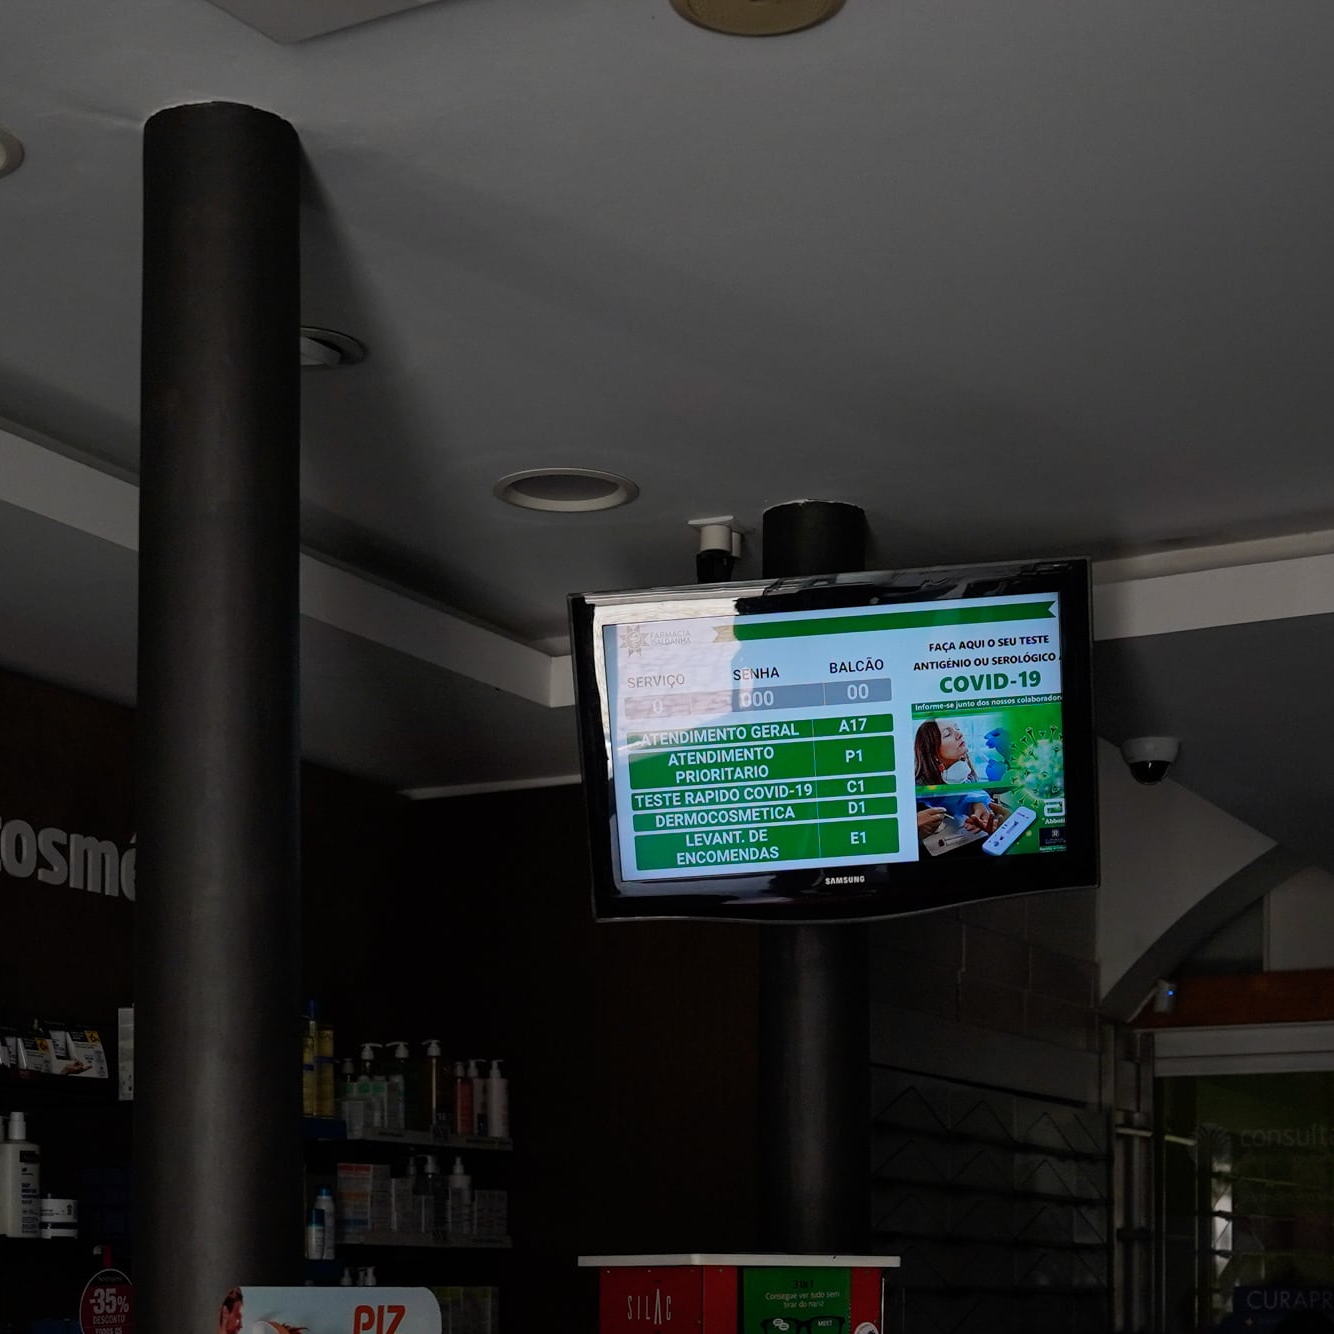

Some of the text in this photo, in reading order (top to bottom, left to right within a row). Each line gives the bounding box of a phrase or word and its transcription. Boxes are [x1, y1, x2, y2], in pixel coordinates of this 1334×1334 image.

[929, 635, 1049, 653] FAÇA AQUI O SEU TESTE
[913, 651, 1056, 671] ANTIGÉNIO OU SEROLÓGICO
[627, 656, 884, 689] SERVIÇO SENHA BALCÃO
[939, 670, 1041, 693] COVID-19
[641, 717, 868, 747] ATENDIMENTO GERAL A17
[668, 746, 863, 767] ATENDIMENTO P1
[675, 765, 770, 784] PRIORITARIO
[634, 779, 866, 808] TESTE RAPIDO COVID-19 C1
[655, 800, 866, 829] DERMOCOSMETICA D1
[685, 828, 867, 847] LEVANT. DE E1
[676, 846, 780, 866] ENCOMENDAS
[824, 875, 865, 886] SAMSUNG
[90, 1287, 130, 1315] -35%
[627, 1288, 672, 1326] SILAC
